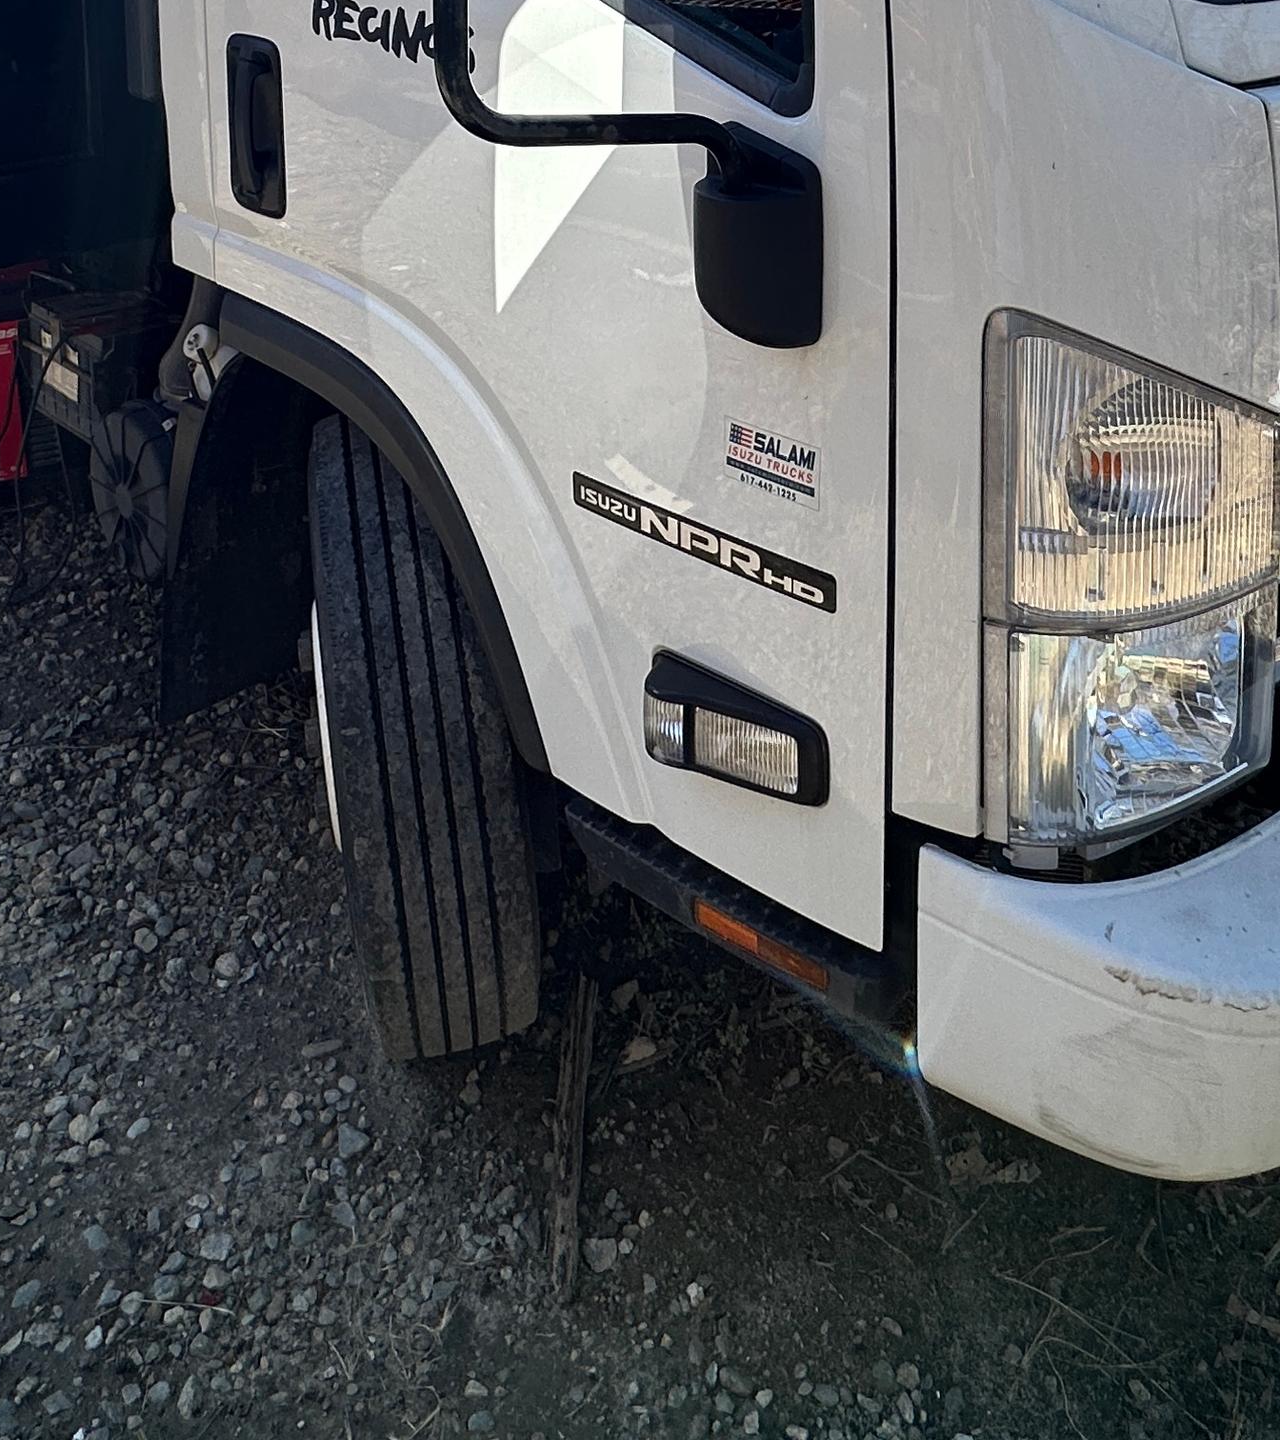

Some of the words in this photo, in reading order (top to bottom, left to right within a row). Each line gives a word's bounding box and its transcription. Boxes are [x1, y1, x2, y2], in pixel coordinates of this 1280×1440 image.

[728, 445, 762, 466] ISUZU
[766, 458, 814, 484] TRUCKS
[753, 431, 816, 471] SALAMI
[740, 473, 797, 502] 617-442-1225
[580, 485, 636, 522] ISUZU
[640, 506, 762, 579] NPR
[763, 568, 825, 604] HD
